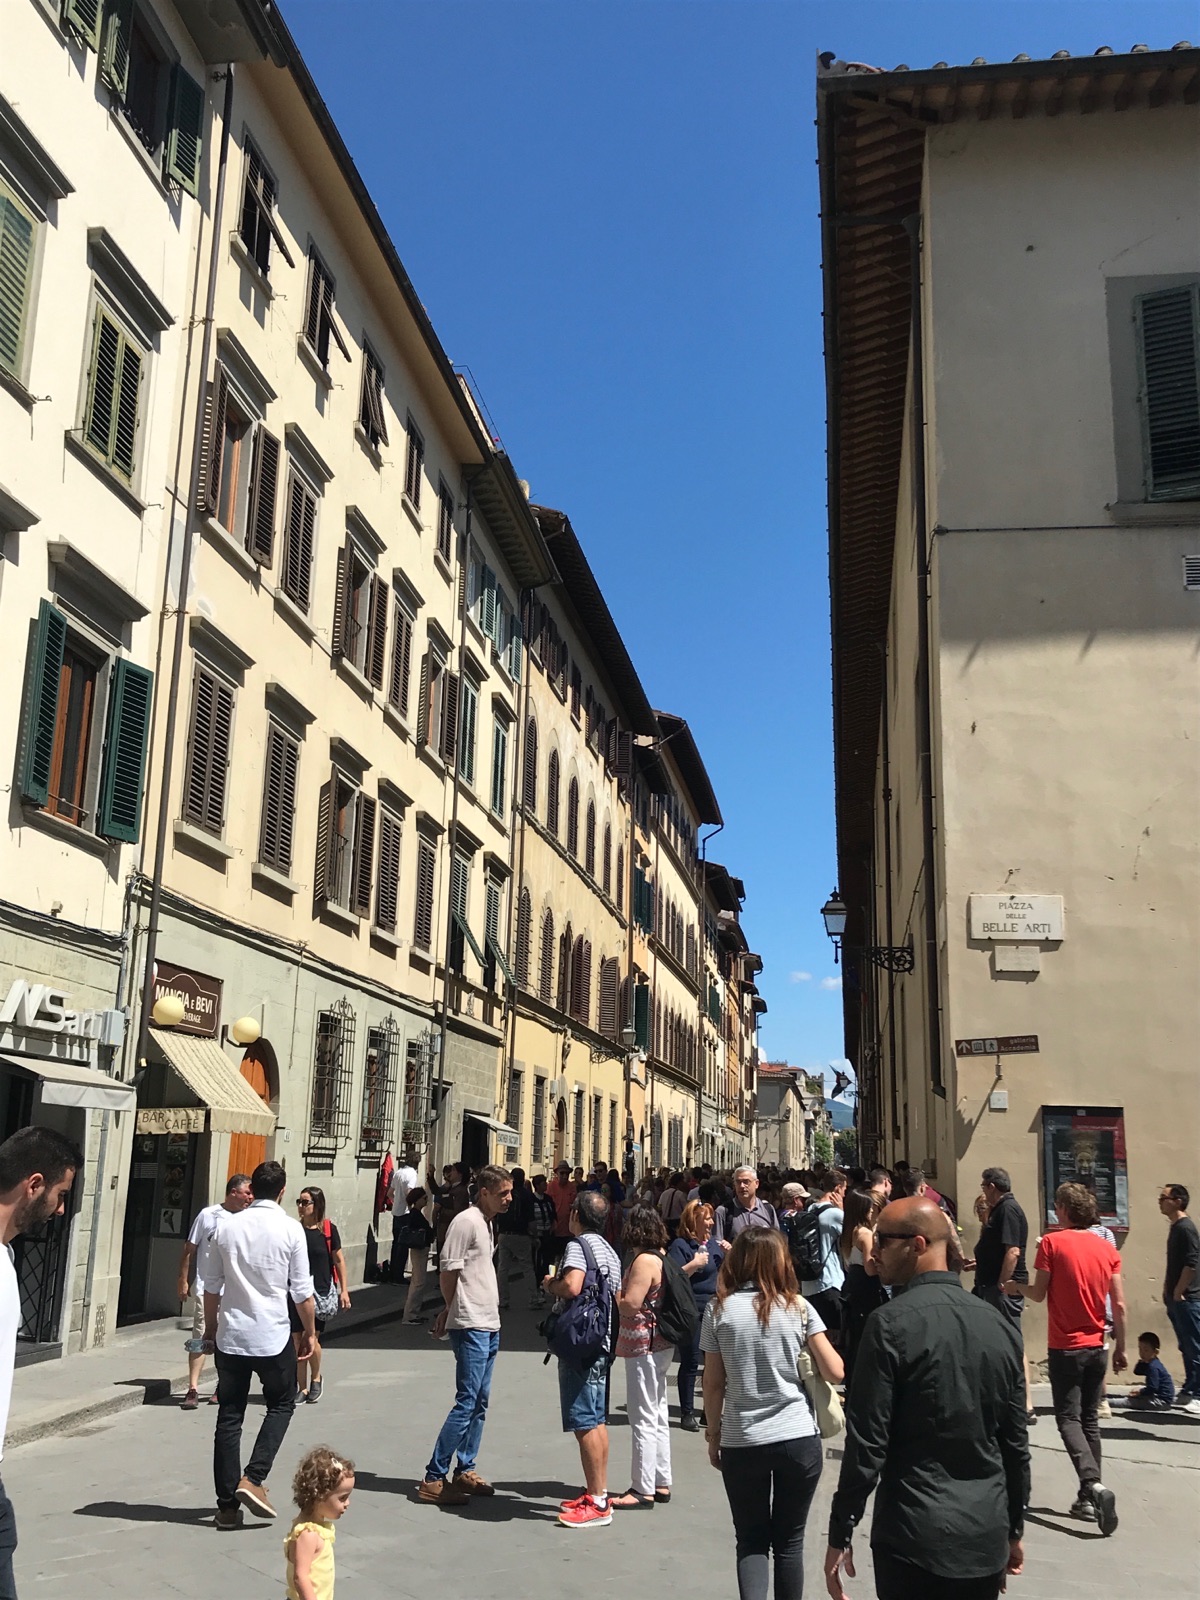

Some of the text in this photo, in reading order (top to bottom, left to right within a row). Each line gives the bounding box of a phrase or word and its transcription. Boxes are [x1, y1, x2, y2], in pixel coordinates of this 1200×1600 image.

[998, 902, 1034, 910] PIAZZA
[982, 922, 1051, 933] BELLE ARTI
[196, 995, 213, 1014] BEVI
[183, 1012, 202, 1024] EVERAGE
[1000, 1044, 1036, 1052] Accademia
[142, 1112, 199, 1130] BAR CAFFÈ
